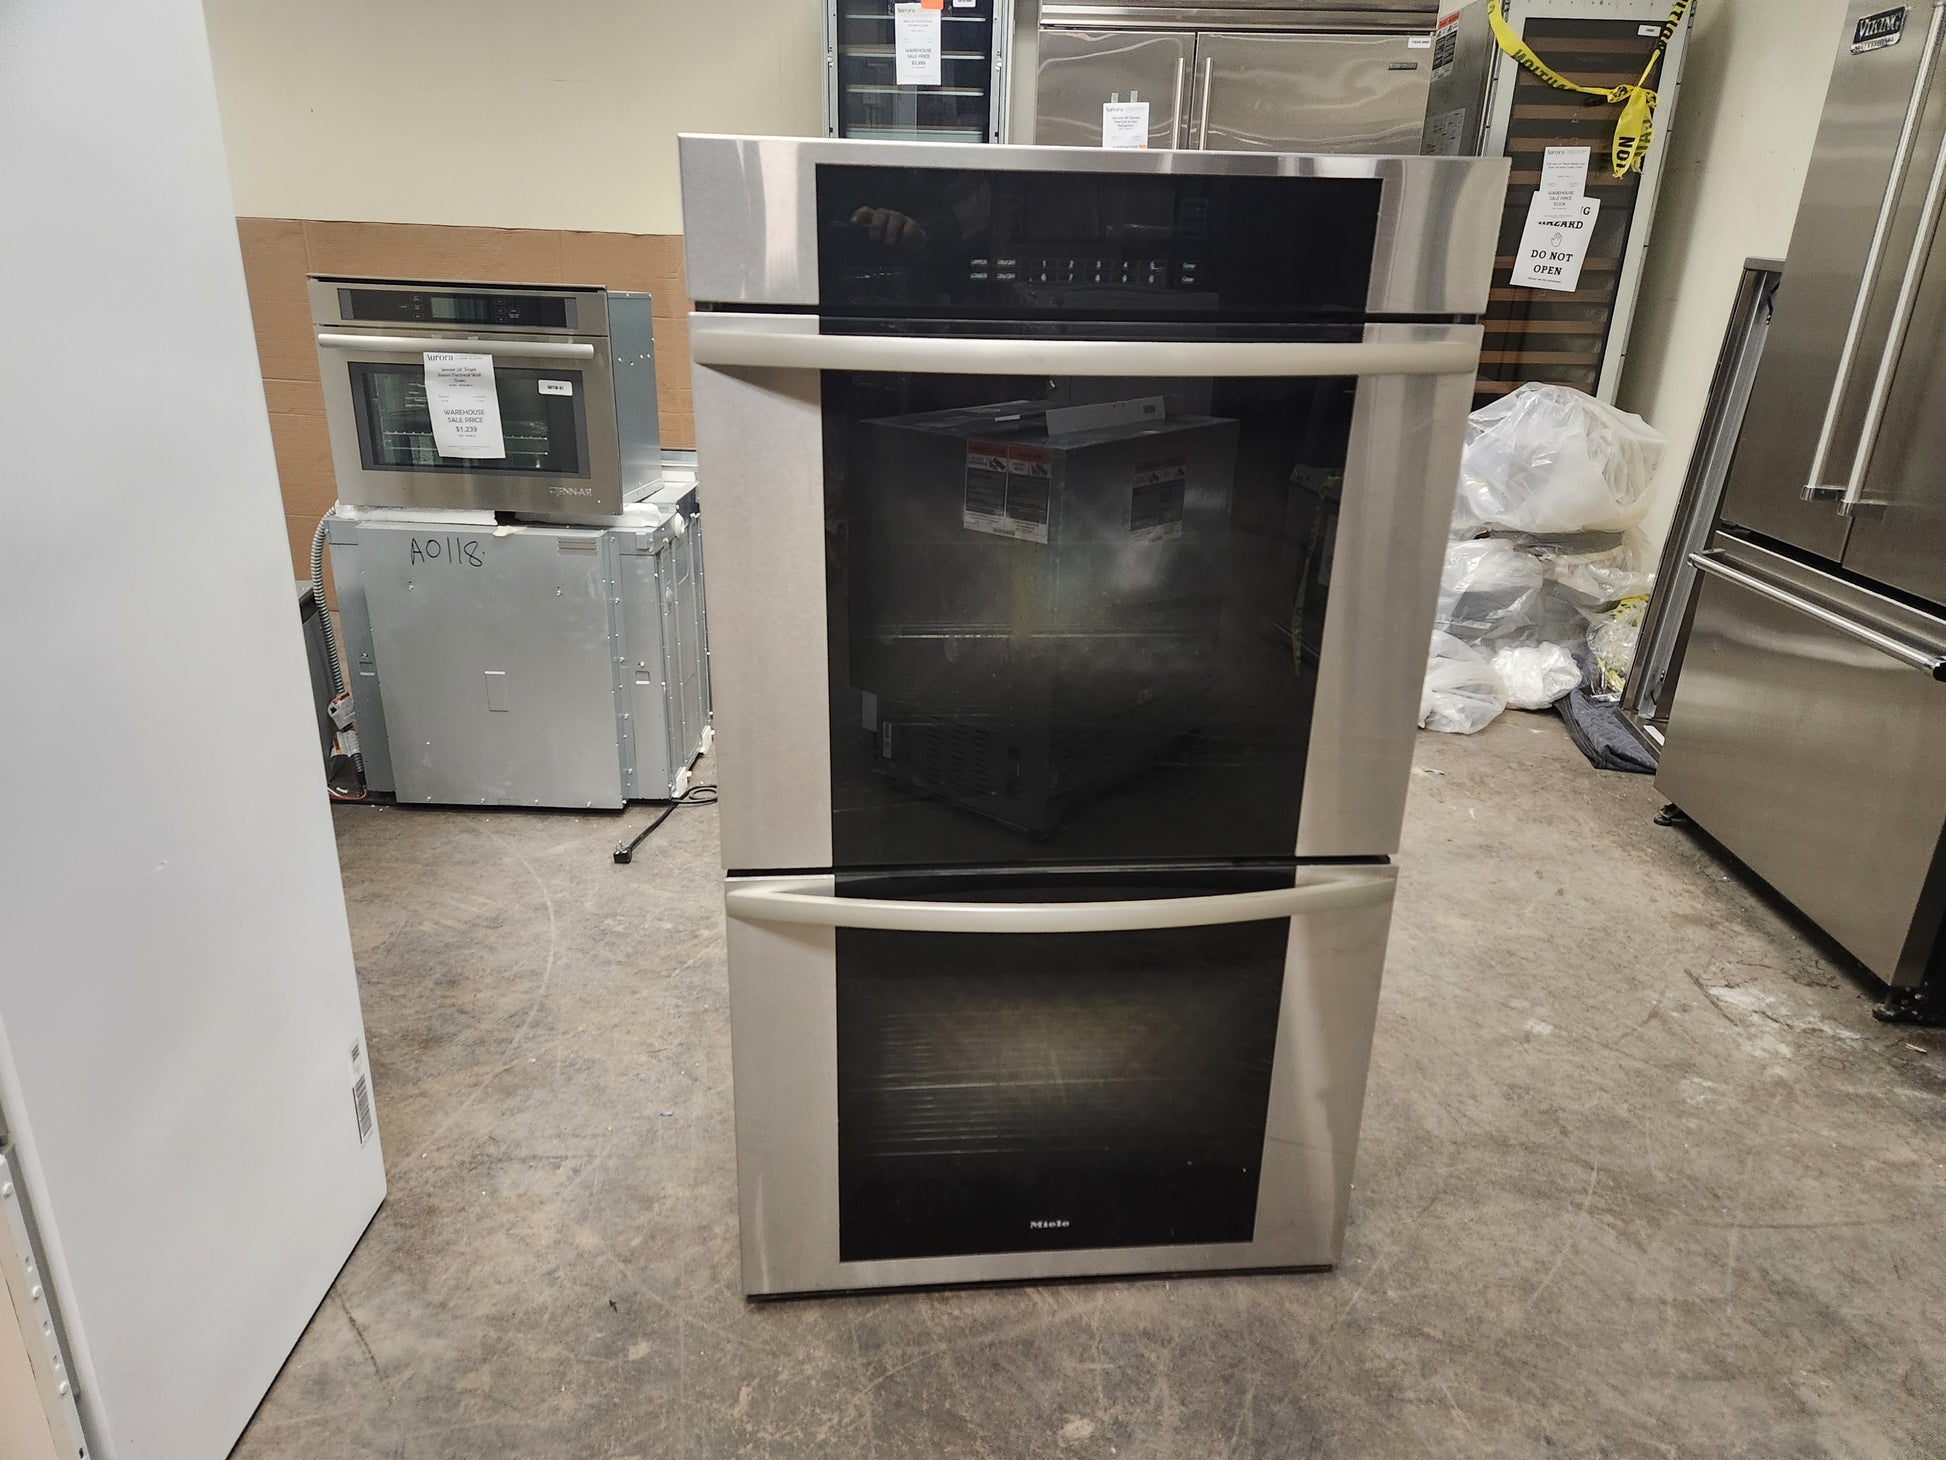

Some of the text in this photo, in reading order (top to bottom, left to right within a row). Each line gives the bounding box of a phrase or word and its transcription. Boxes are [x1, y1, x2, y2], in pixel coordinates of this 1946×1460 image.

[1860, 12, 1903, 40] VIKING
[1530, 249, 1574, 262] DO NOT
[1533, 264, 1563, 276] OPEN
[444, 408, 485, 416] WAREHOUSE
[447, 416, 484, 424] SALE PRICE
[1030, 1219, 1070, 1229] Miele
